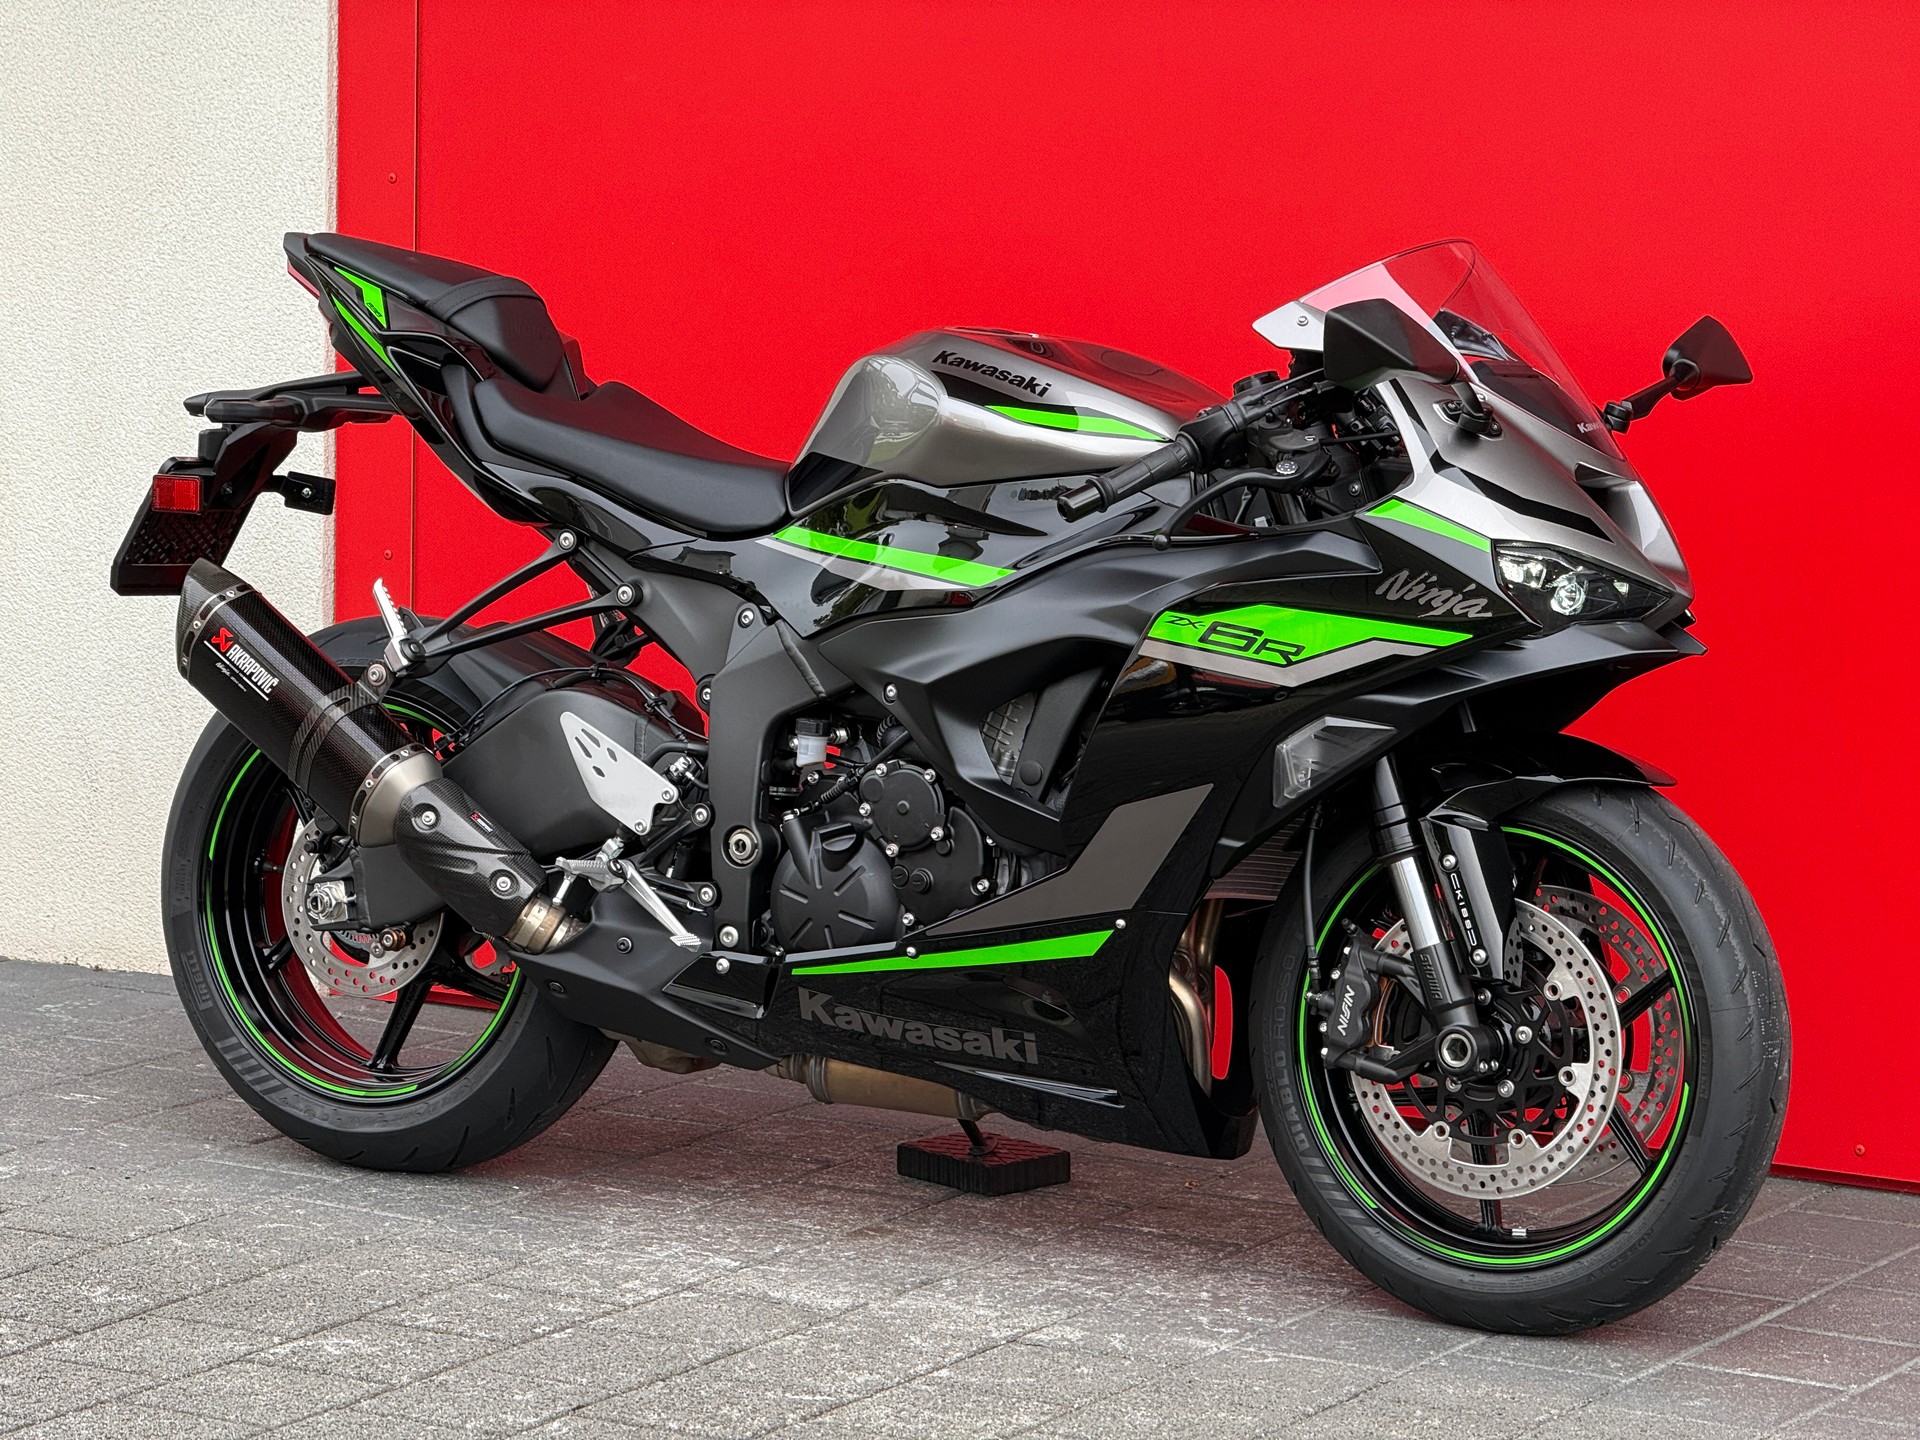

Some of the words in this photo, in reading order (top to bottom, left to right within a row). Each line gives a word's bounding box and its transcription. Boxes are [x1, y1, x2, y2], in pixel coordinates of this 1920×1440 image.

[932, 350, 1052, 398] Kawasaki
[1375, 569, 1493, 619] Ninja
[1164, 615, 1306, 668] ZX-6R
[225, 643, 280, 694] AKRAPOVIČ
[1272, 955, 1295, 1040] ROSSO
[1419, 953, 1443, 1001] SHOWA
[798, 986, 1039, 1065] Kawasaki
[1337, 985, 1356, 1037] NISSIN
[1274, 1050, 1310, 1152] DIABLO
